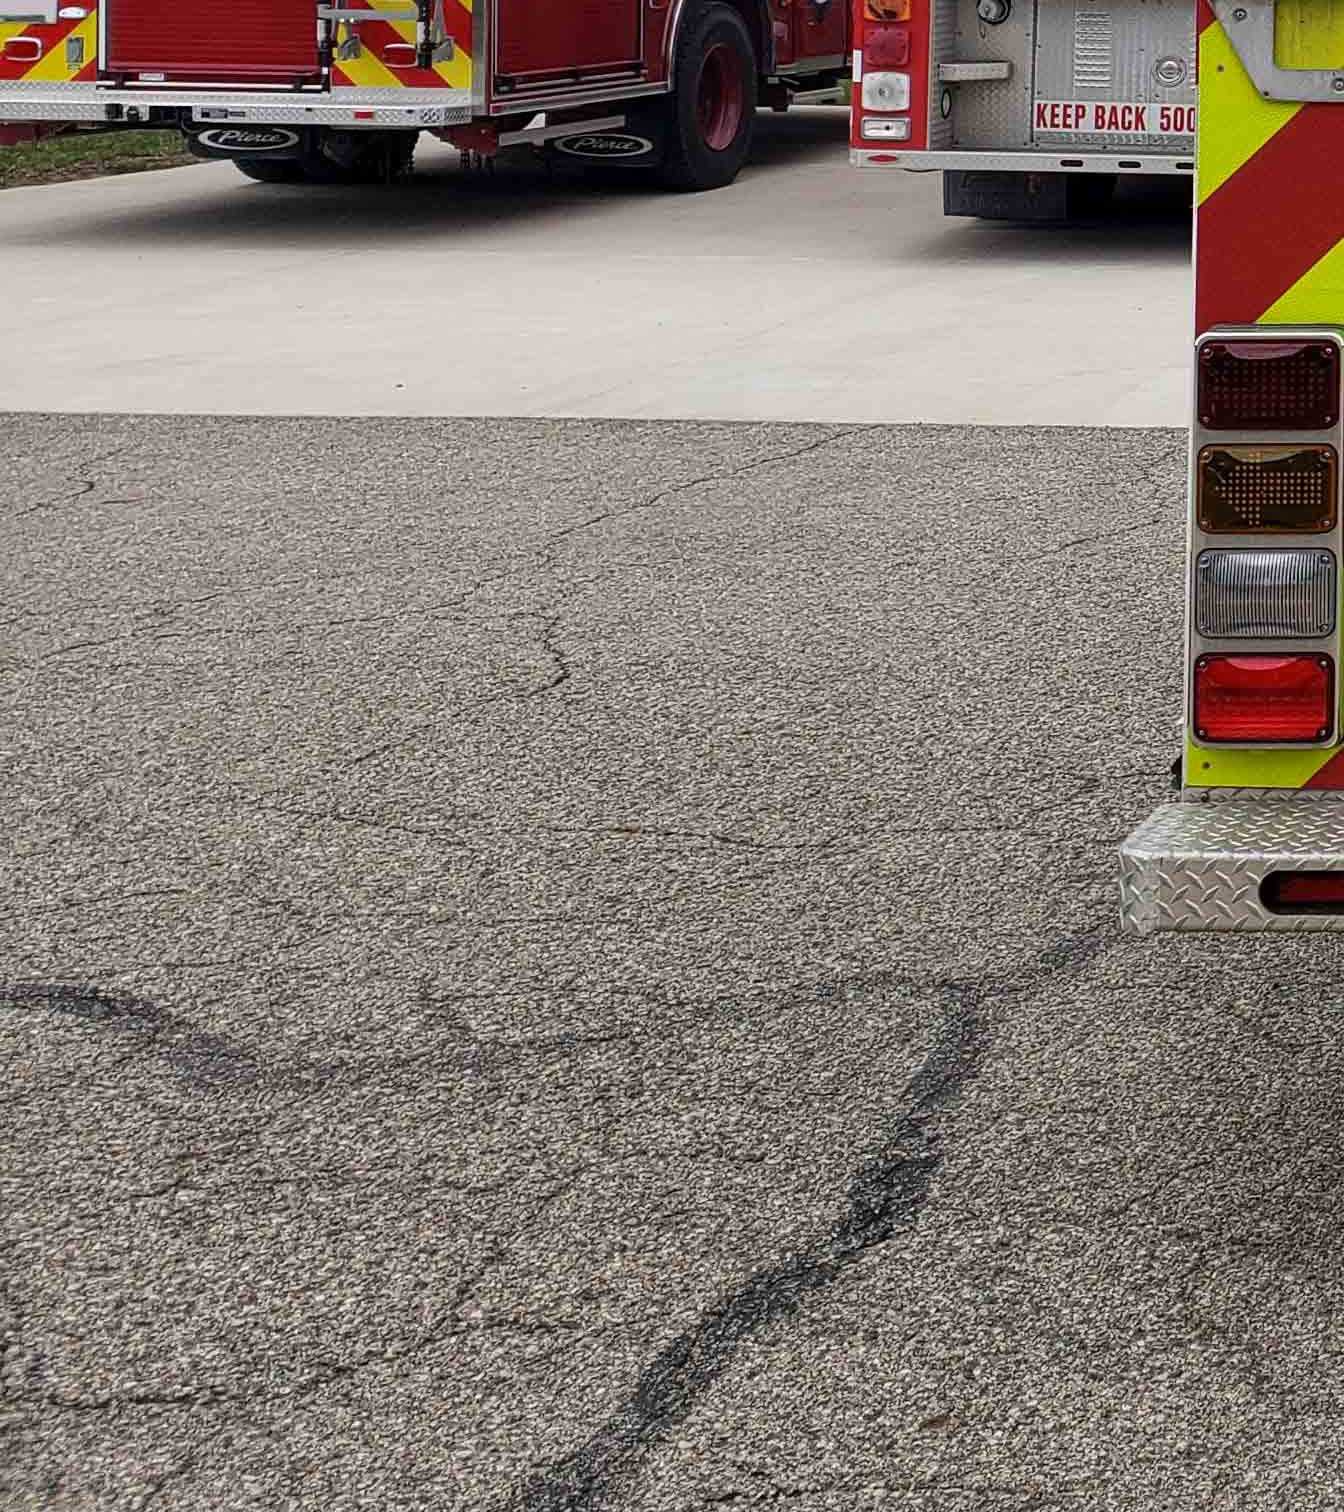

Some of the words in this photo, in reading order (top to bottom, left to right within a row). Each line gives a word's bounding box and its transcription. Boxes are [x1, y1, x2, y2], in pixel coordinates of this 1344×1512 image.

[1036, 103, 1086, 130] KEEP
[1094, 105, 1146, 131] BACK
[218, 130, 281, 143] Pierce
